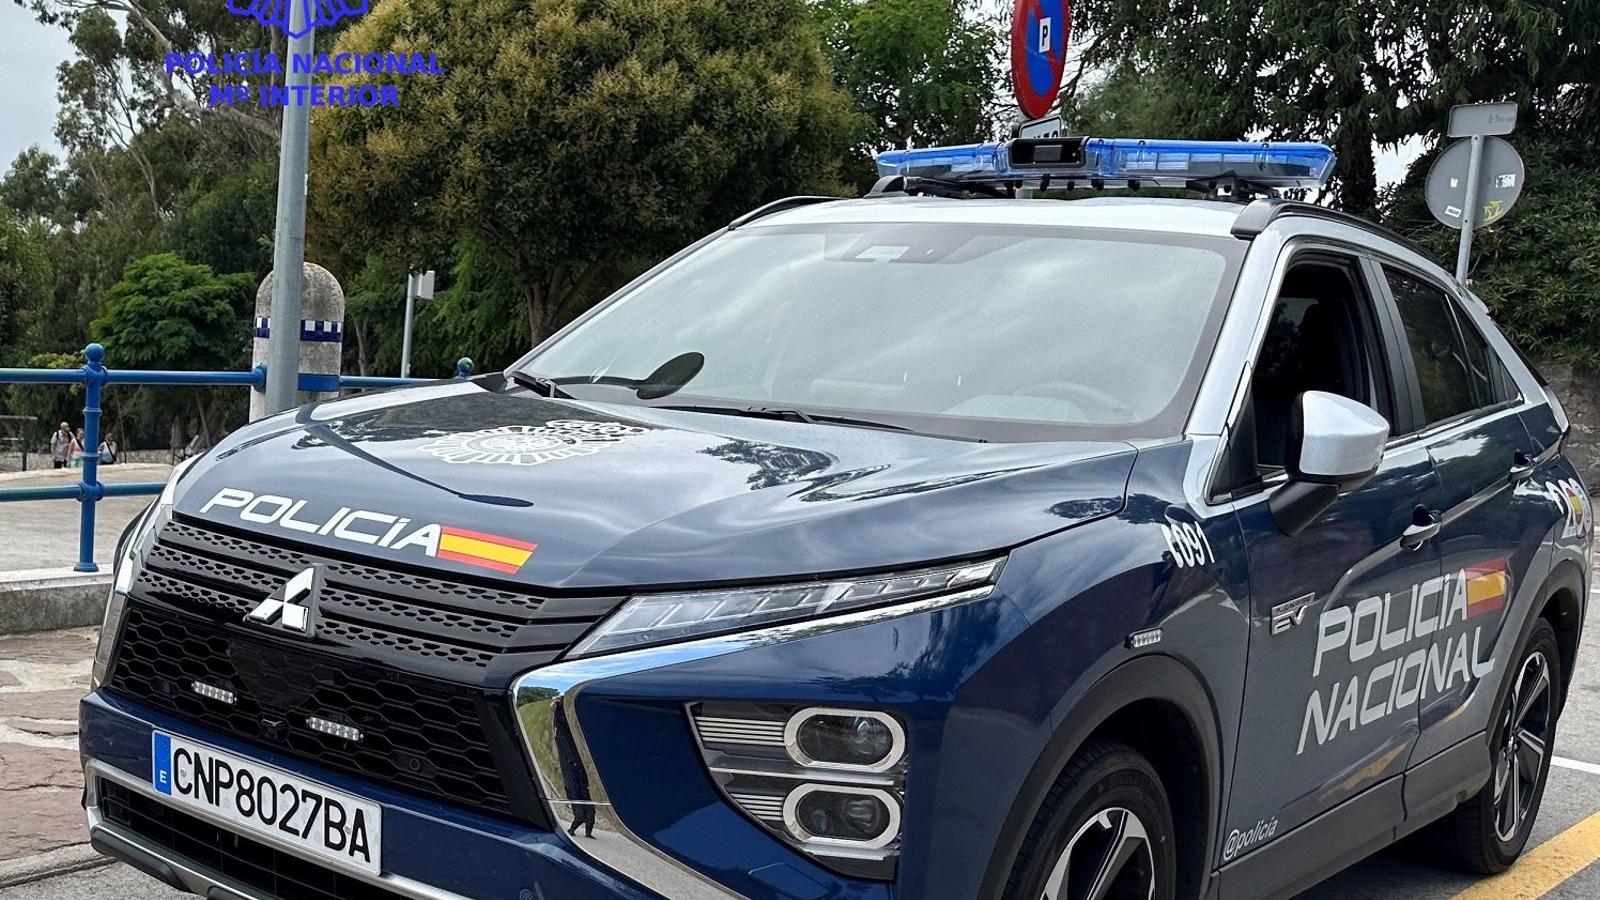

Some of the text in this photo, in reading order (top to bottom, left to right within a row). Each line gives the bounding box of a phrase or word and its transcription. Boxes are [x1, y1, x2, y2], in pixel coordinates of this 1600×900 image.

[1042, 25, 1048, 46] P
[199, 487, 442, 558] POLICÍA
[1312, 568, 1468, 677] POLICÍA
[1296, 626, 1496, 756] NACIONAL
[159, 748, 371, 863] E CNP8027BA
